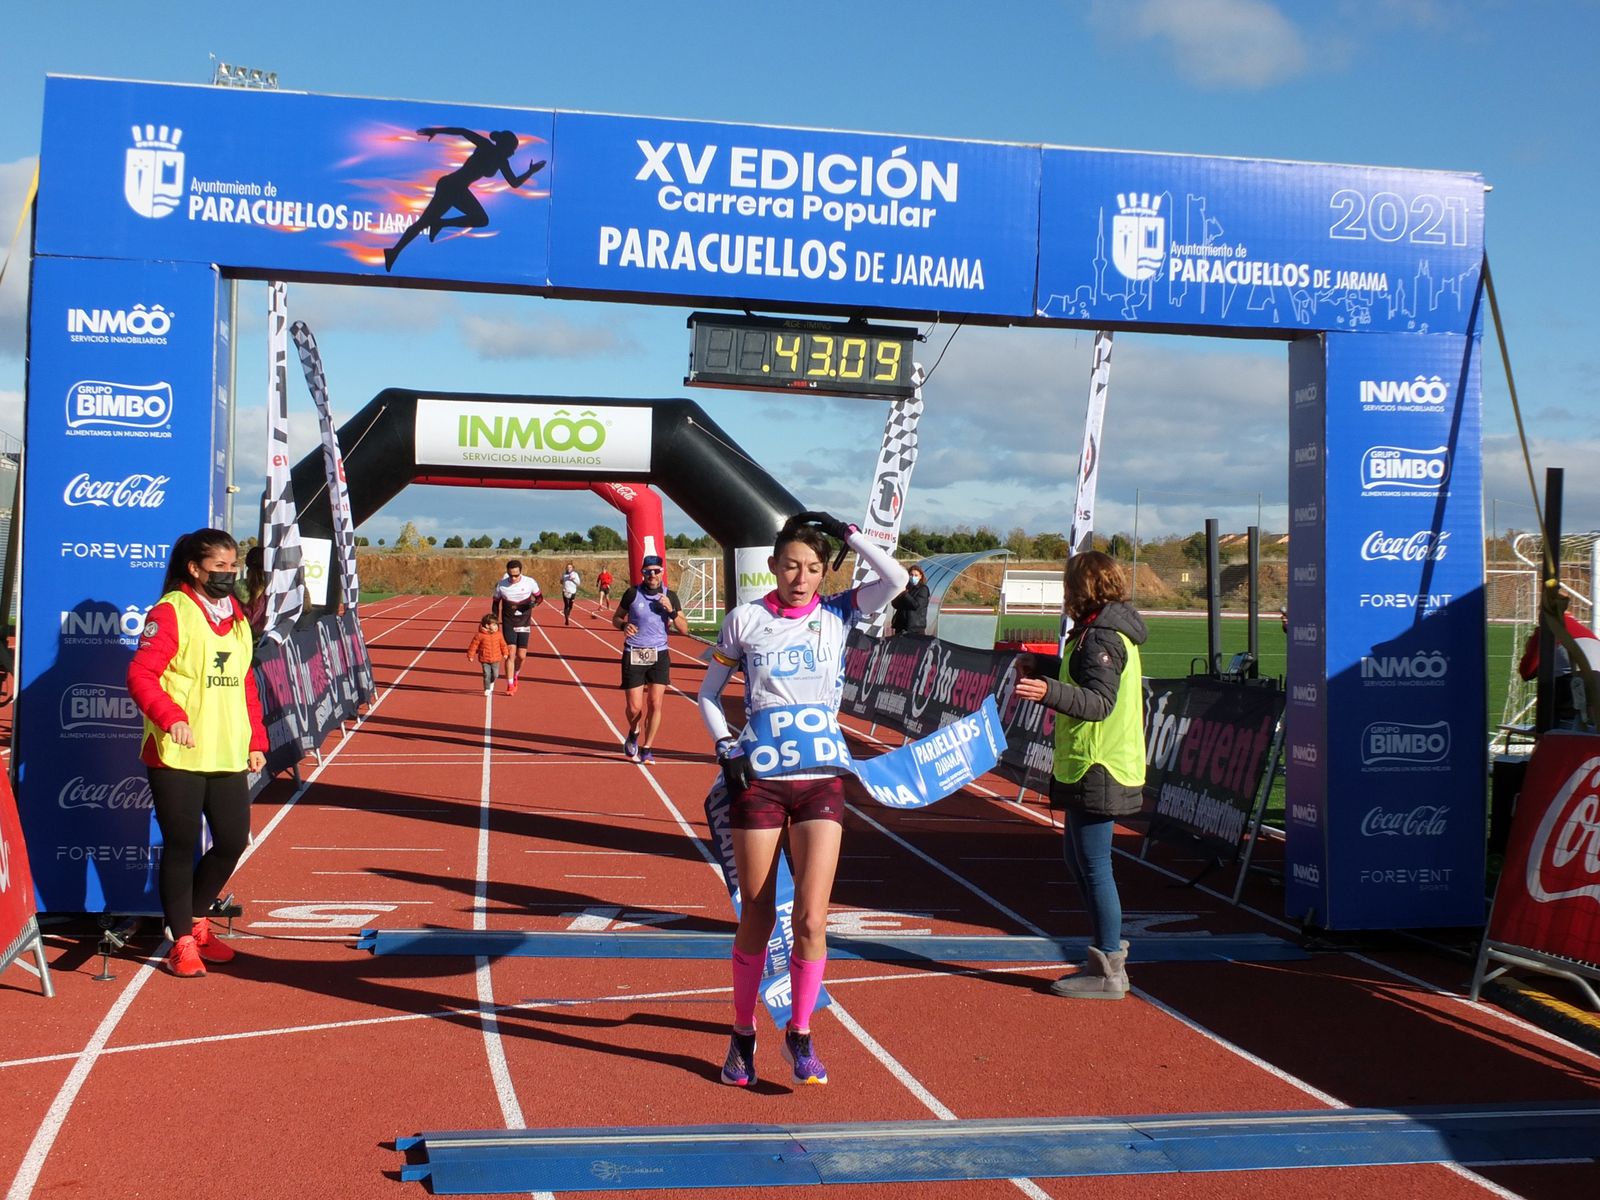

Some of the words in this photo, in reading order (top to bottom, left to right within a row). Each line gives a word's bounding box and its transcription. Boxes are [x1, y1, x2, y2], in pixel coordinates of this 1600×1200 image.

[635, 139, 717, 184] XV
[730, 146, 958, 202] EDICIÓN
[190, 177, 262, 197] Ayuntamiento
[263, 182, 278, 197] de
[188, 196, 348, 230] PARACUELLOS
[352, 211, 372, 230] DE
[658, 185, 794, 219] Carrera
[802, 195, 936, 231] Popular
[1329, 188, 1469, 247] 2021
[599, 226, 847, 281] PARACUELLOS
[855, 251, 885, 285] DE
[890, 254, 985, 291] JARAMA
[1170, 240, 1233, 257] Ayuntamiento
[1234, 244, 1247, 258] de
[1169, 258, 1310, 288] PARACUELLOS
[1313, 269, 1332, 288] DE
[1333, 271, 1388, 292] JARAMA
[70, 335, 109, 343] SERVICIOS
[111, 336, 168, 345] INMOBILIARIOS
[77, 386, 113, 394] GRUPO
[77, 394, 166, 418] BIMBO
[462, 452, 518, 463] SERVICIOS
[520, 454, 601, 466] INMOBILIARIOS
[1370, 451, 1401, 459] GRUPO
[1369, 459, 1445, 479] BIMBO
[63, 473, 171, 508] Coca-Cola
[61, 542, 171, 559] FOREVENT
[1361, 530, 1453, 561] Coca-Cola
[130, 561, 165, 569] SPORTS
[1360, 593, 1453, 608] FOREVENT
[753, 641, 833, 670] arregui
[206, 675, 239, 689] Joma
[72, 688, 106, 697] GRUPO
[71, 697, 145, 719] BIMB
[1370, 726, 1400, 734] GRUPO
[1369, 733, 1446, 754] BIMBO
[1361, 805, 1451, 837] Coca-Cola
[57, 845, 164, 861] FOREVENT
[1360, 868, 1453, 884] FOREVENT
